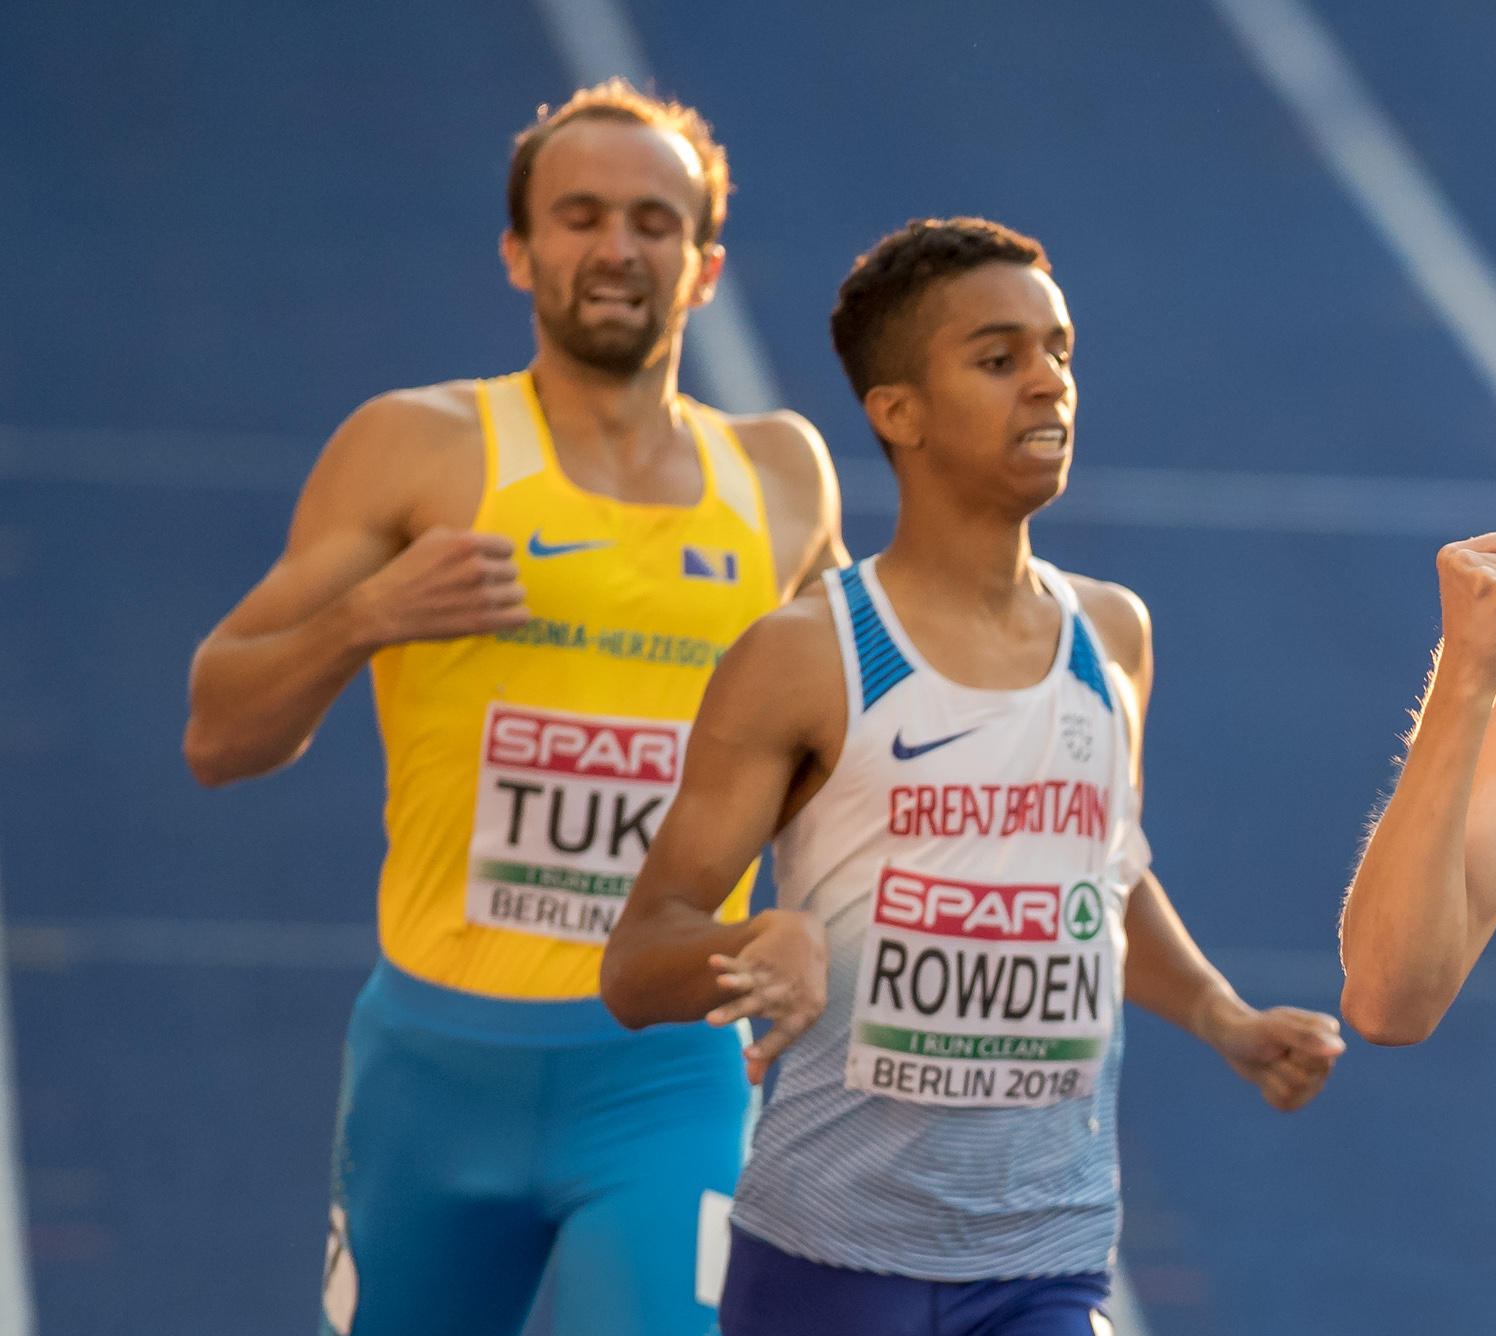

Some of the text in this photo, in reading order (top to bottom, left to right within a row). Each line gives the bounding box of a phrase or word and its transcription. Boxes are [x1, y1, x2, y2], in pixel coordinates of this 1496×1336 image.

[494, 716, 675, 778] SPAR
[497, 778, 664, 858] TUK
[889, 785, 1000, 837] GREAT
[491, 886, 617, 934] BERLIN
[882, 877, 1056, 937] SPAR
[869, 938, 1101, 1021] ROWDEN
[924, 1033, 973, 1057] RUN
[873, 1055, 1081, 1099] BERLIN 2018
